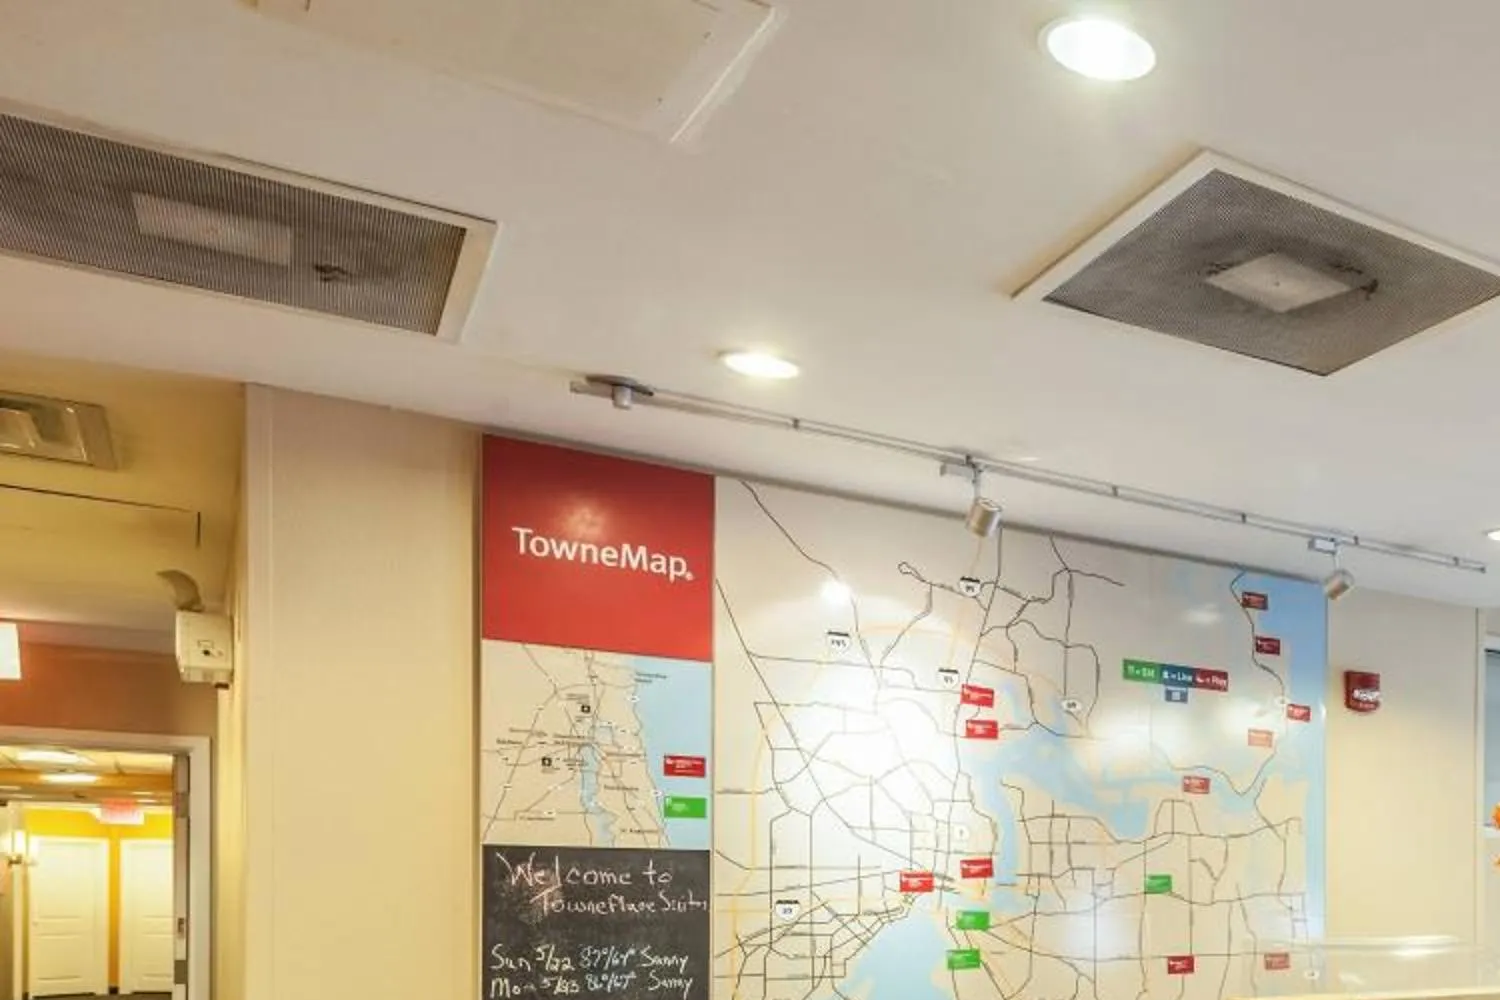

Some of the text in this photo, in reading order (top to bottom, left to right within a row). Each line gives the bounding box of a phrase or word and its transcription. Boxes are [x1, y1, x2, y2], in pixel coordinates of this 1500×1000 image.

[496, 852, 673, 886] Welcome to
[490, 943, 531, 971] Sun
[535, 944, 576, 971] 5/22
[641, 945, 689, 974] Sunny
[489, 977, 536, 999] Mon
[648, 969, 693, 1000] Sunny
